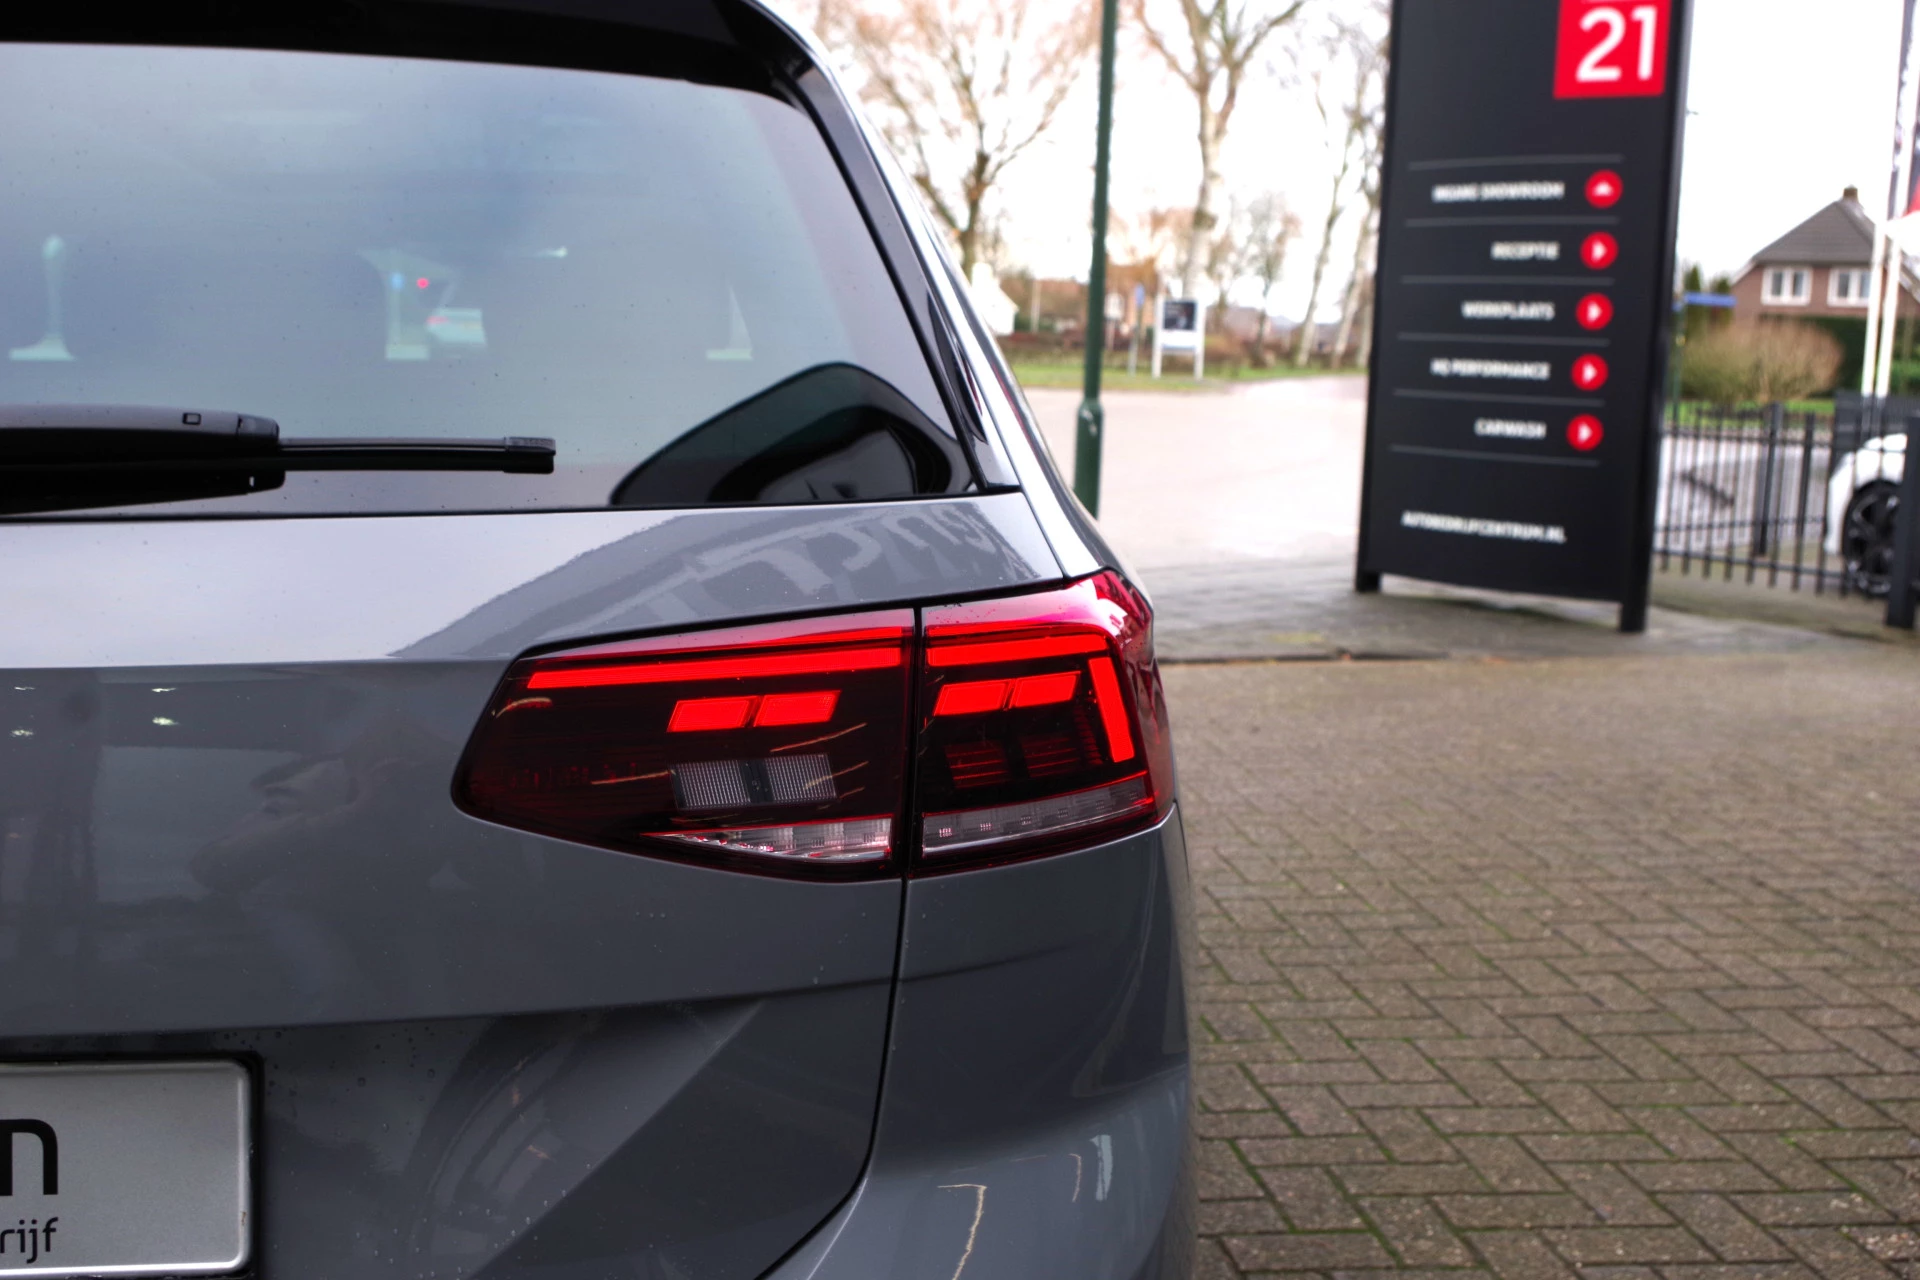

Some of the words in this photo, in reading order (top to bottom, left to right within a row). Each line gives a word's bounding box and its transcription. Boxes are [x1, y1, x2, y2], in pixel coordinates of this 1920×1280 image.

[1575, 5, 1658, 83] 21
[1479, 181, 1565, 201] SHOWROOM
[1491, 242, 1559, 260] RECEPTIE
[1461, 301, 1555, 320] WERKPLAATS
[1453, 360, 1550, 380] PERFORMANCE
[1475, 419, 1546, 438] CARWASH
